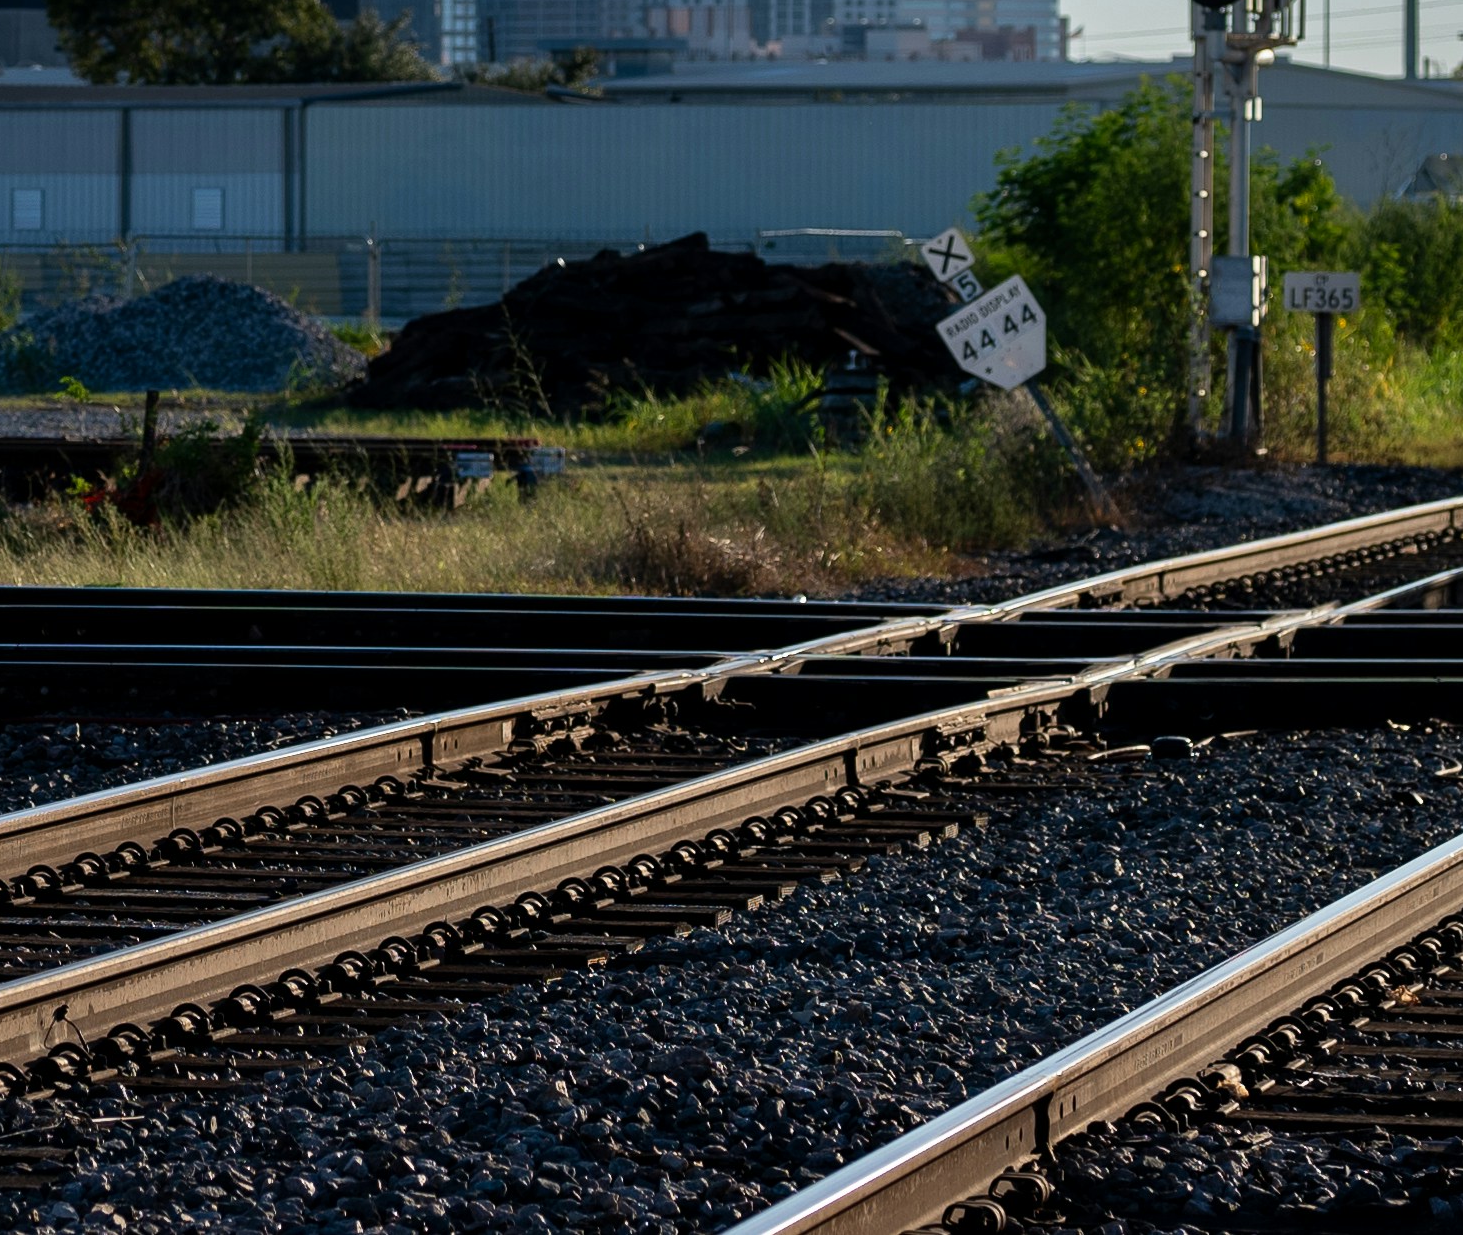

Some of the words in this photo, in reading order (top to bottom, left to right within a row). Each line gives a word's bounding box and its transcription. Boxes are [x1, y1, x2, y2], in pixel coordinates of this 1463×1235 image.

[957, 274, 978, 299] 5
[1290, 287, 1354, 310] LF365
[945, 310, 979, 339] RADIO
[979, 283, 1022, 318] DISPLAY
[962, 328, 997, 362] 44
[1003, 303, 1037, 335] 44
